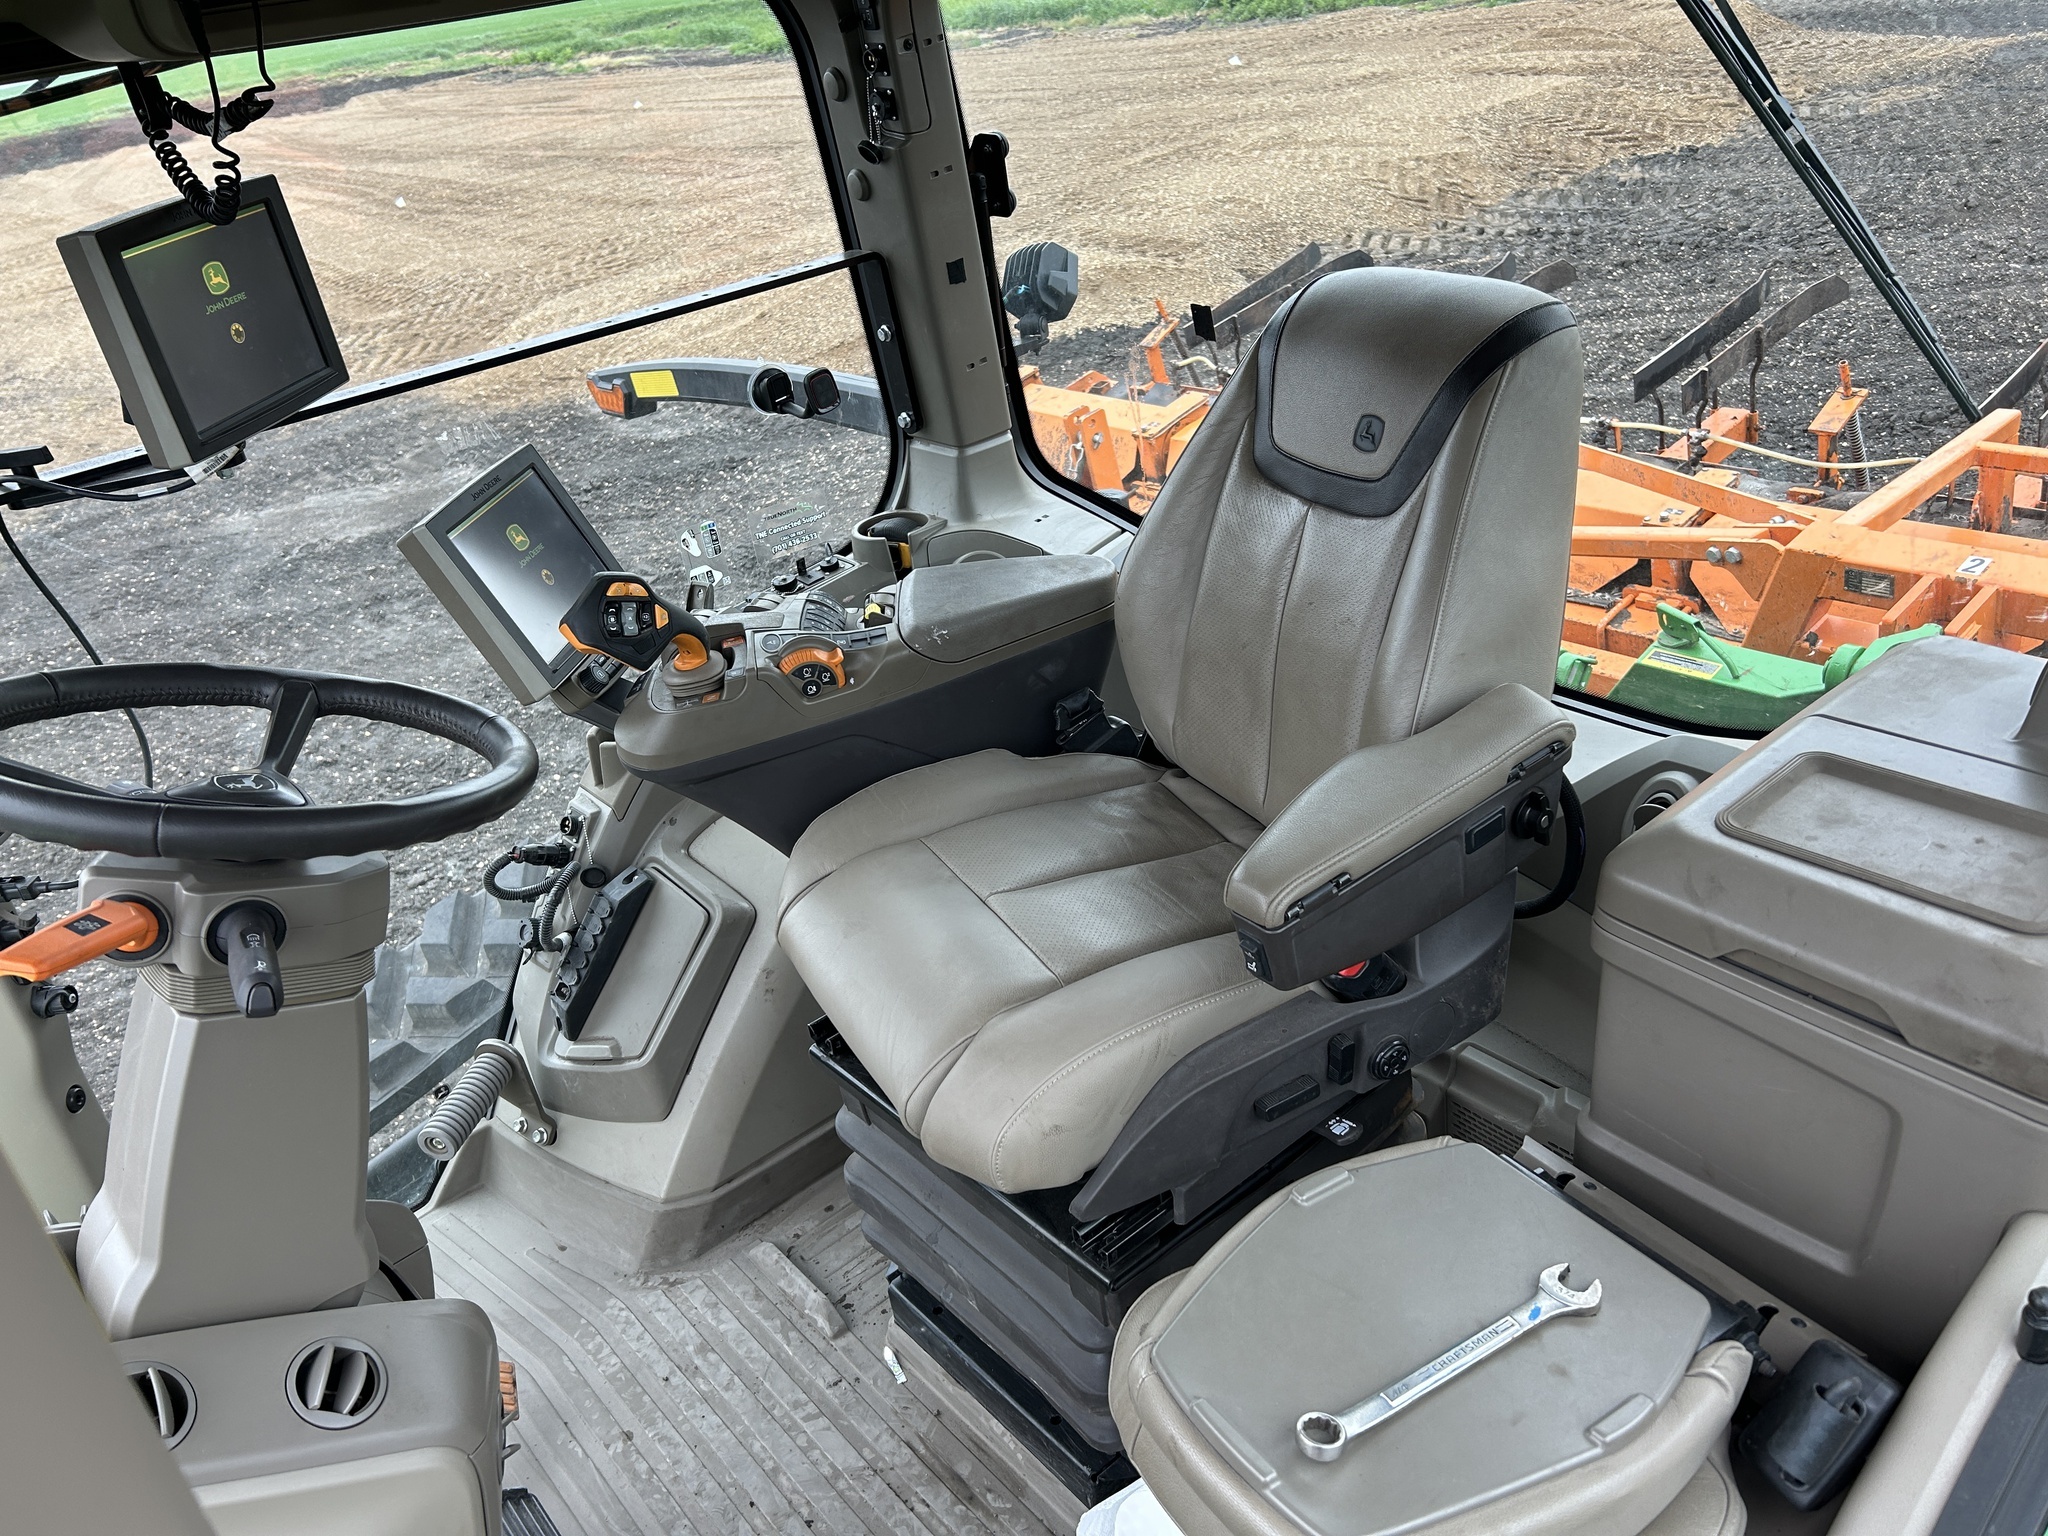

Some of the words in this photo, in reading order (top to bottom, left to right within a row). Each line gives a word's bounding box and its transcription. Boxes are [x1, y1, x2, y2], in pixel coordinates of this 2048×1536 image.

[205, 300, 224, 315] JOHN
[224, 292, 247, 307] DEERE
[471, 487, 485, 501] JOHN
[484, 475, 502, 491] DEERE
[755, 532, 768, 540] TNE
[768, 520, 802, 535] Connected
[802, 511, 827, 524] Support
[519, 554, 531, 568] JOHN
[529, 543, 544, 558] DEERE
[1961, 558, 1985, 573] 2
[1431, 1328, 1499, 1372] CRAFTSMAN
